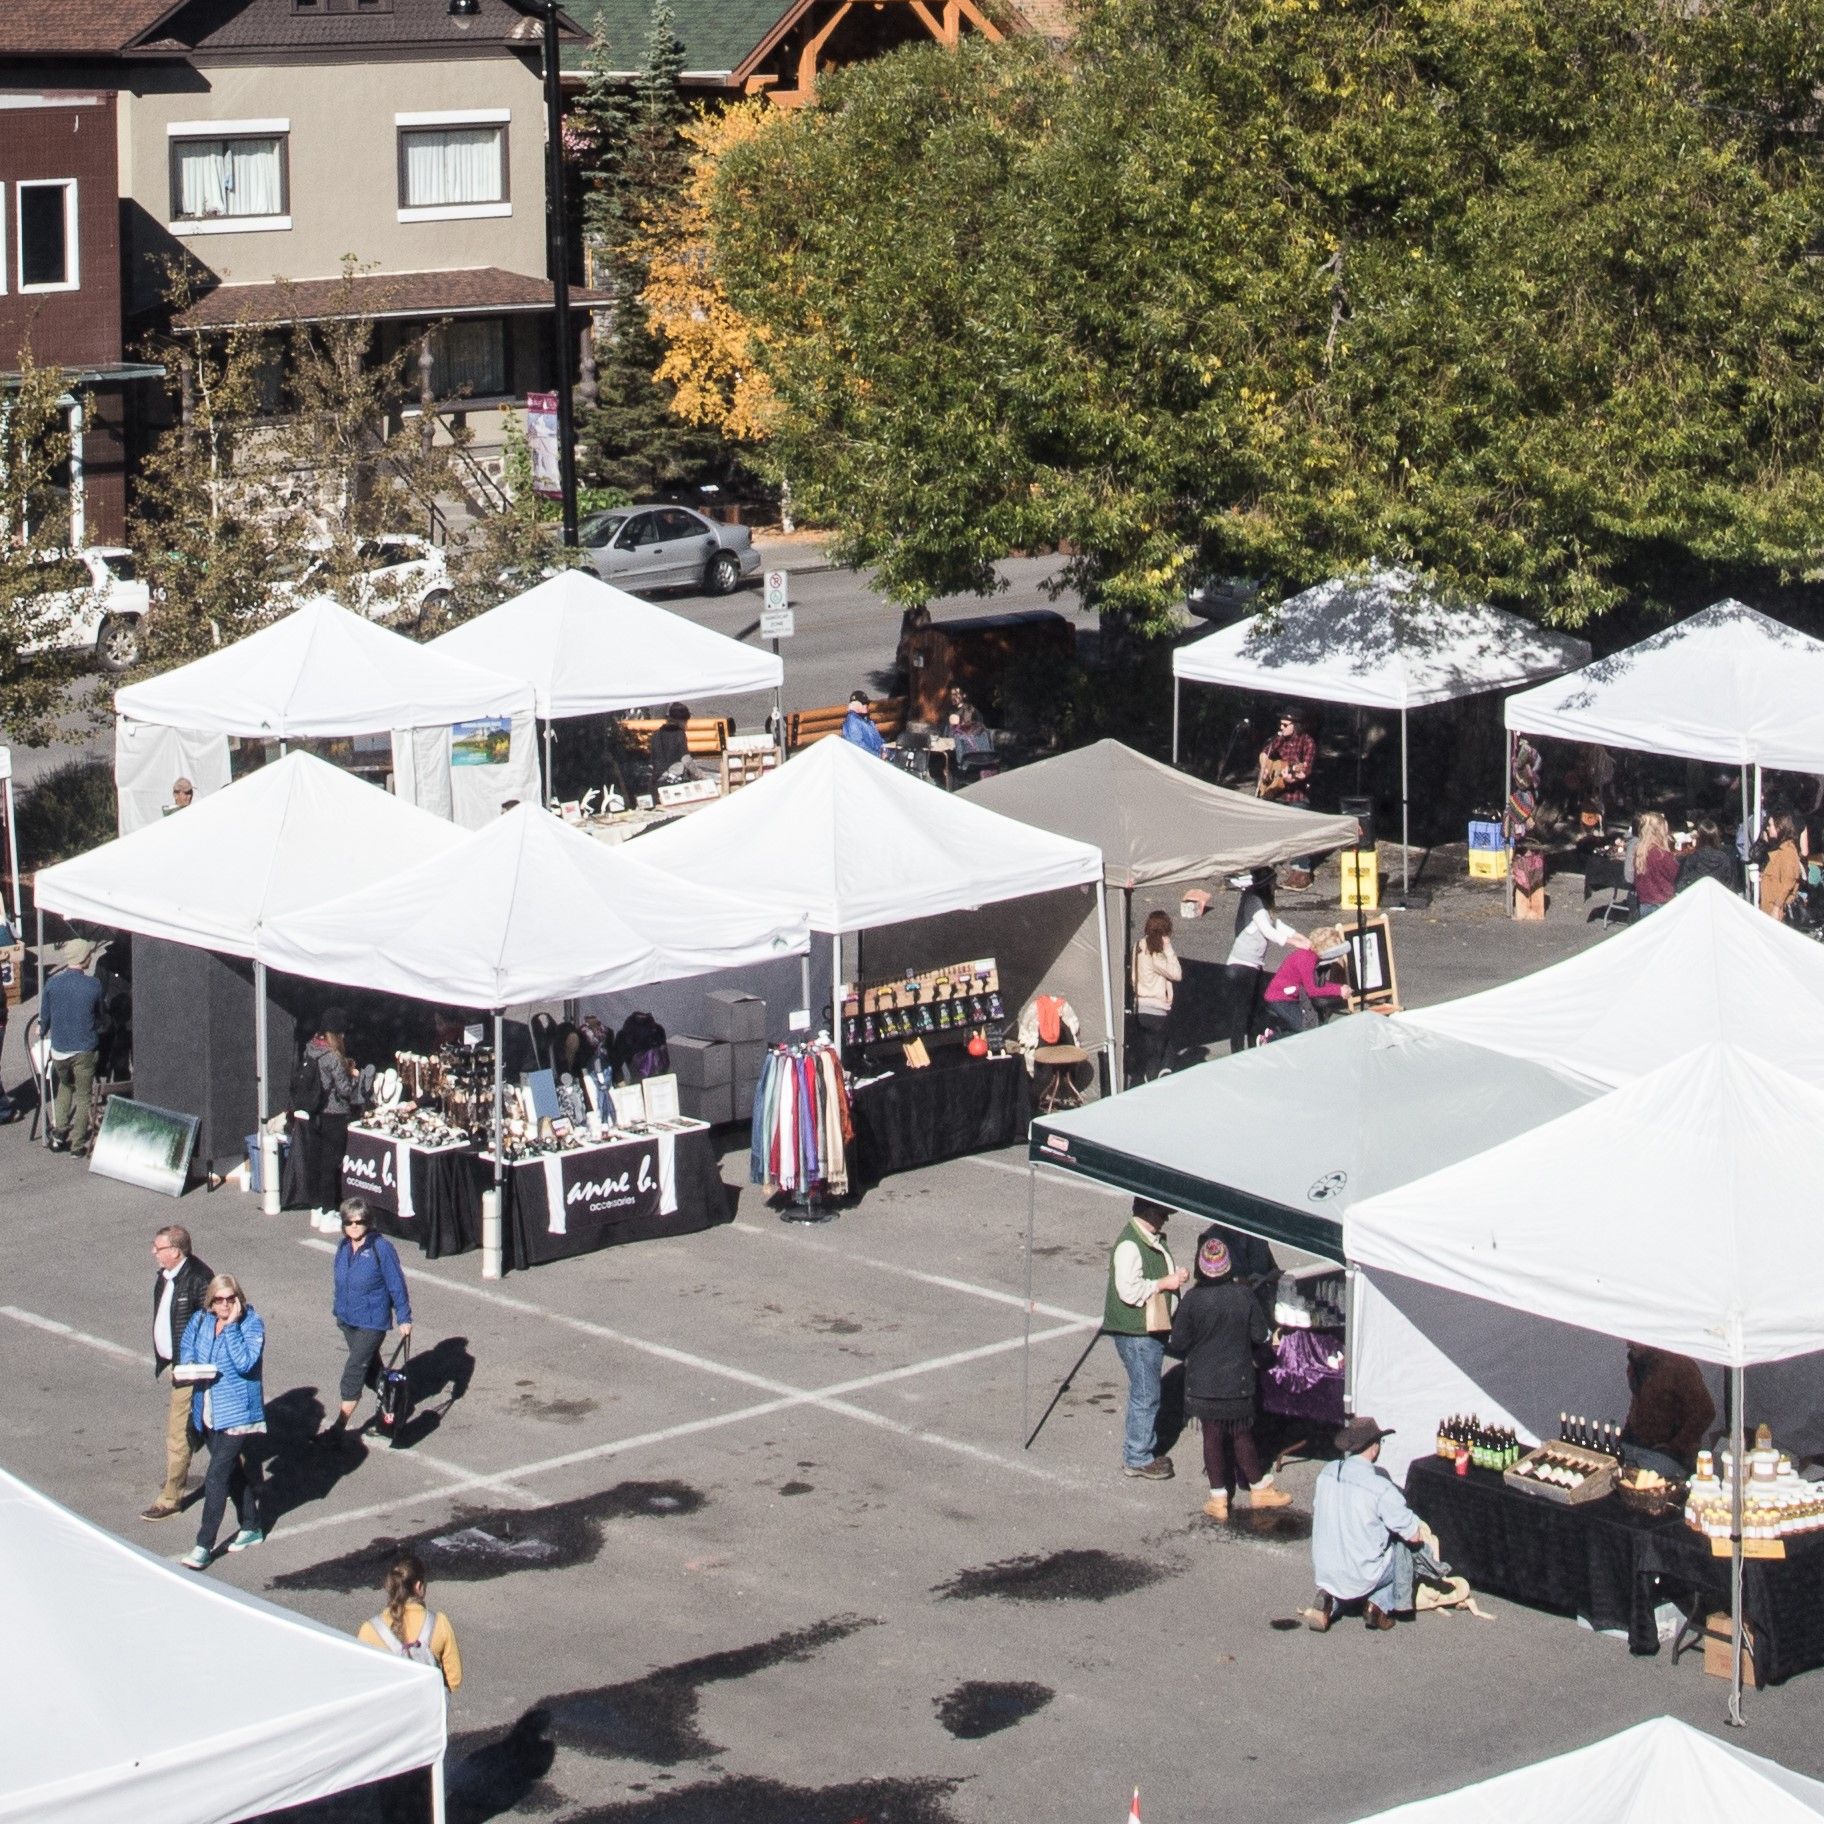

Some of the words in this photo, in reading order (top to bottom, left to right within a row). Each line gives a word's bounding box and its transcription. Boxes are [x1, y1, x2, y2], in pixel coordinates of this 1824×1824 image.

[346, 1176, 382, 1194] accessories
[567, 1172, 629, 1205] anne
[637, 1154, 657, 1190] b.
[590, 1195, 636, 1212] accessories
